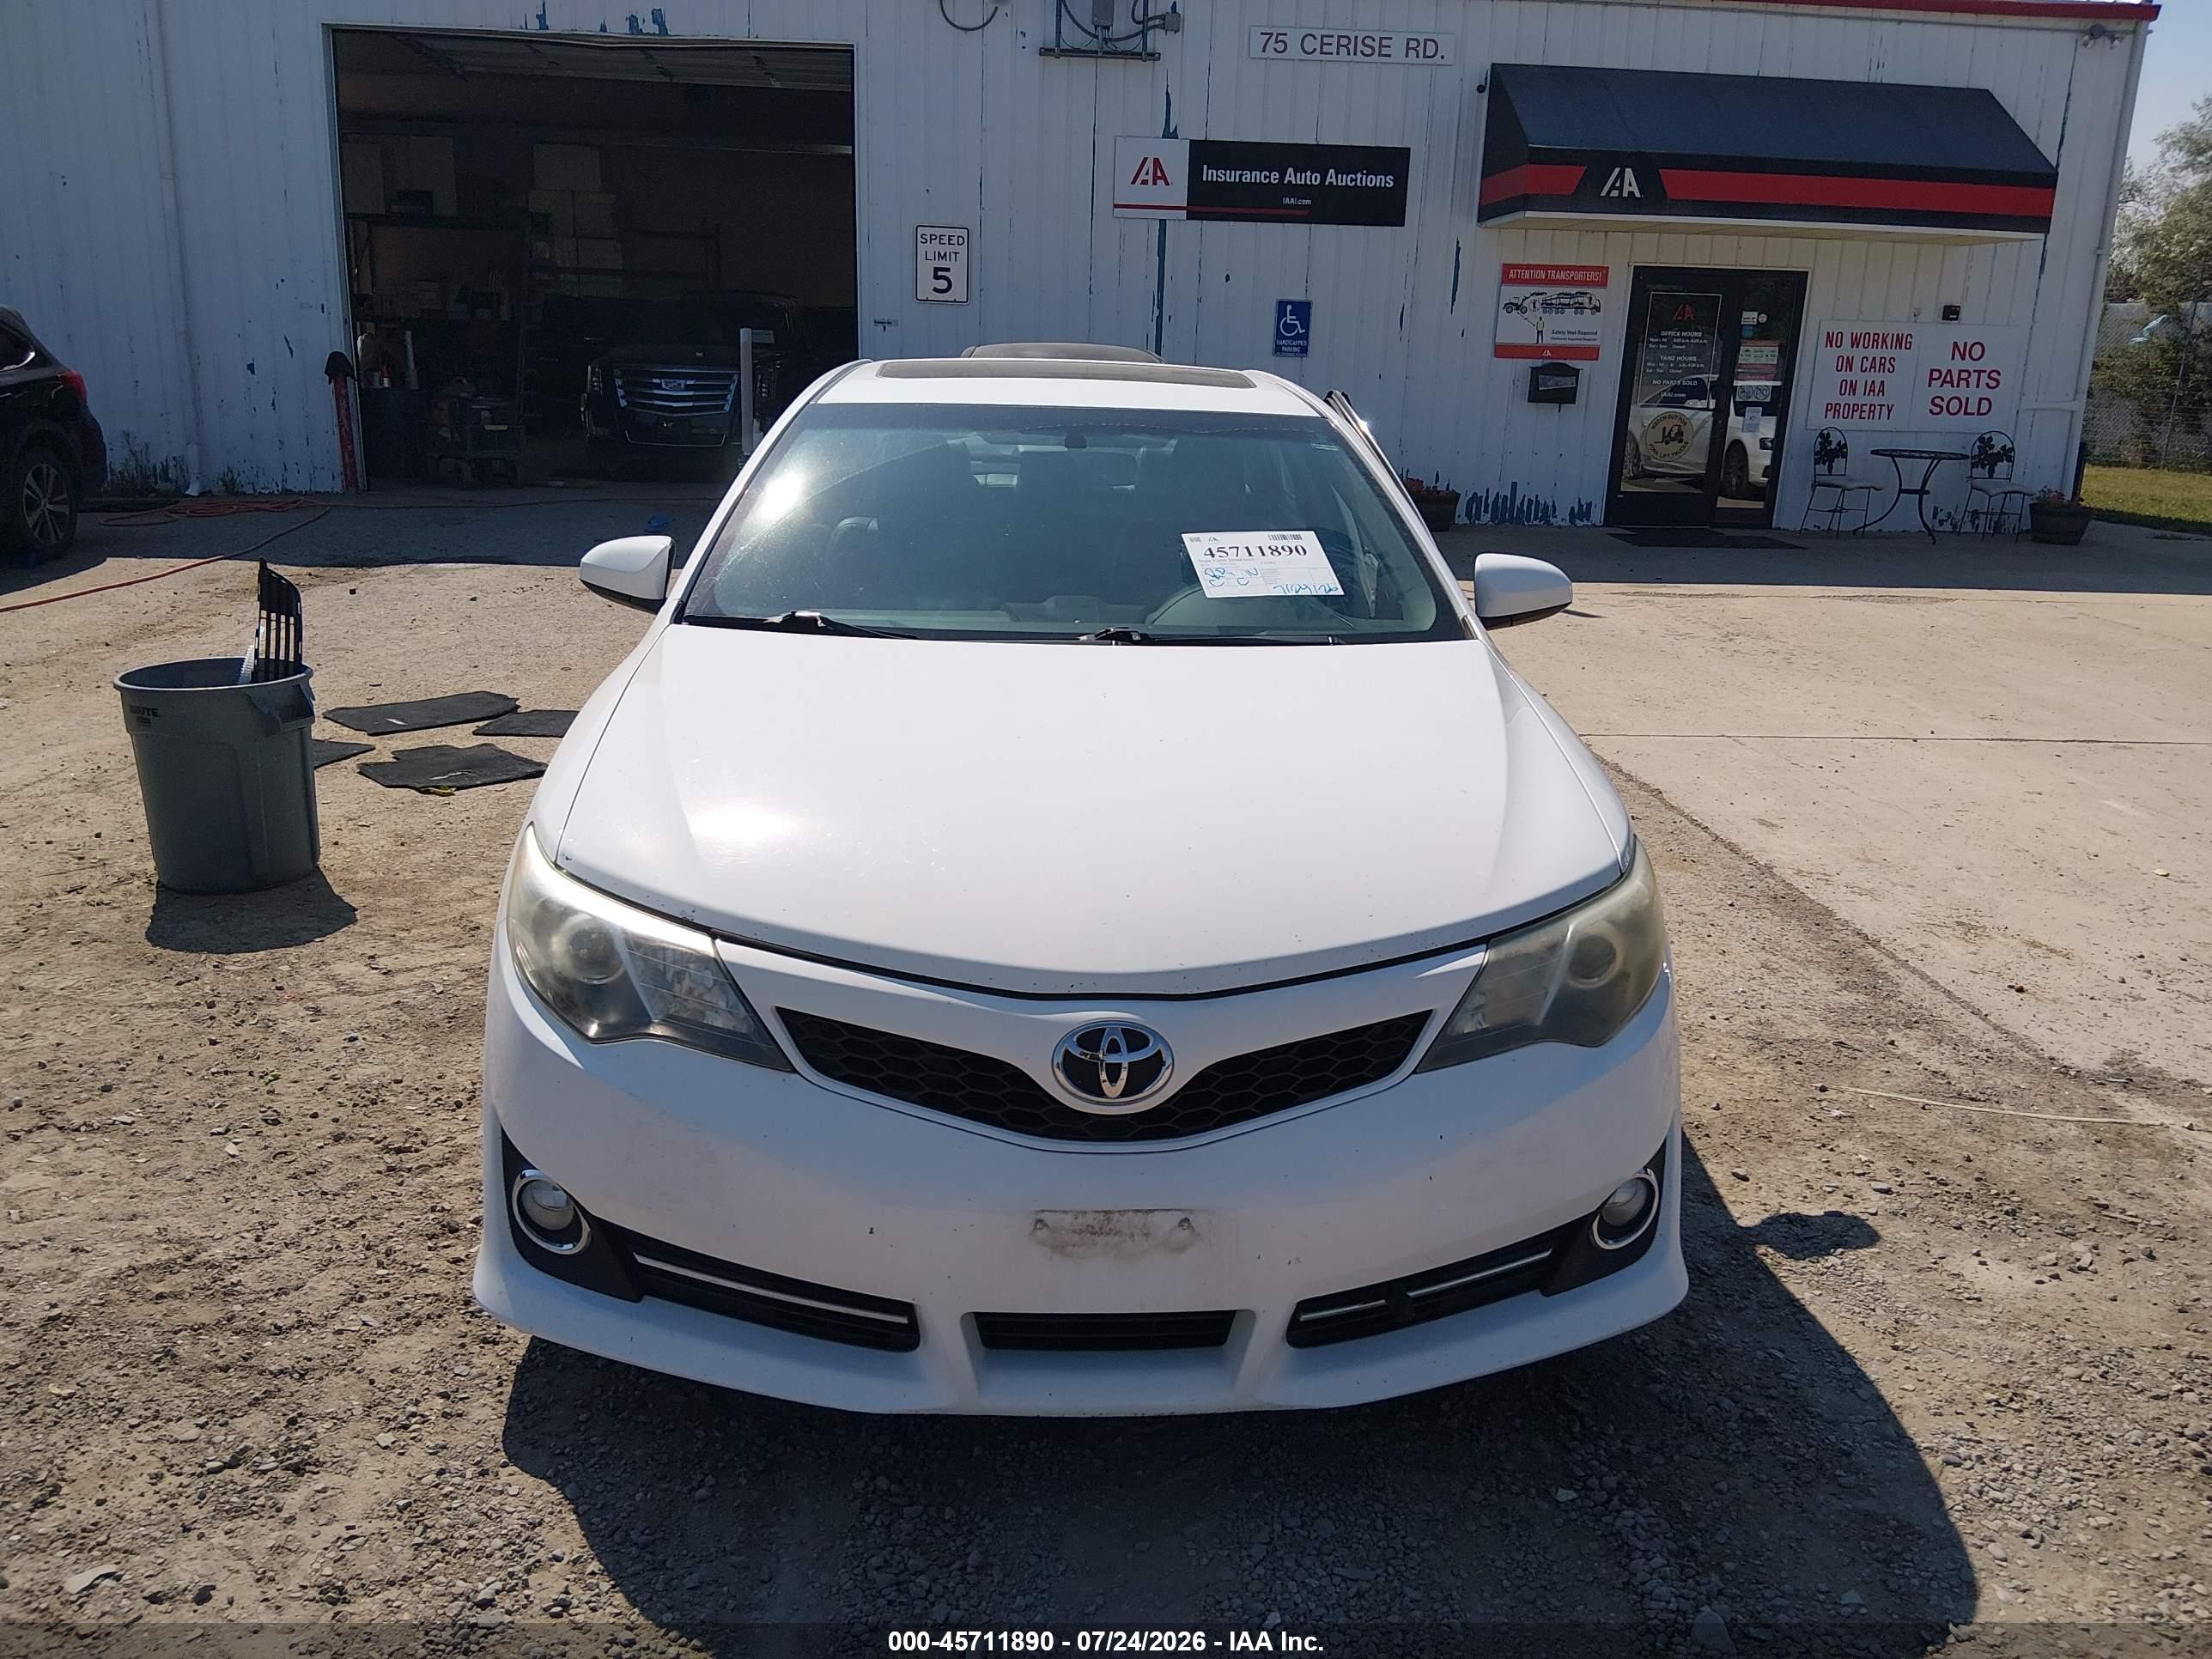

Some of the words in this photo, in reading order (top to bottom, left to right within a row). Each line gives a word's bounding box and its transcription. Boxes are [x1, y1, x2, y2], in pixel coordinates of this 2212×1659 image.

[1260, 32, 1288, 54] 75
[1300, 33, 1393, 58] CERISE
[1405, 38, 1445, 60] RD.
[1202, 164, 1279, 185] Insurance
[1285, 167, 1321, 185] Auto
[1325, 168, 1395, 188] Auctions
[920, 234, 965, 246] SPEED
[925, 250, 960, 262] LIMIT
[933, 267, 952, 294] 5
[1509, 269, 1546, 280] ATTENTION
[1547, 269, 1602, 282] TRANSPORTERS!
[1825, 331, 1844, 349] NO
[1850, 331, 1913, 350] WORKING
[1951, 341, 1986, 362] NO
[1835, 355, 1854, 373] ON
[1860, 356, 1896, 374] CARS
[1928, 368, 2002, 390] PARTS
[1839, 380, 1857, 397] ON
[1863, 380, 1886, 398] IAA
[1825, 403, 1895, 421] PROPERTY
[1929, 396, 1993, 416] SOLD
[1204, 544, 1307, 558] 45711890
